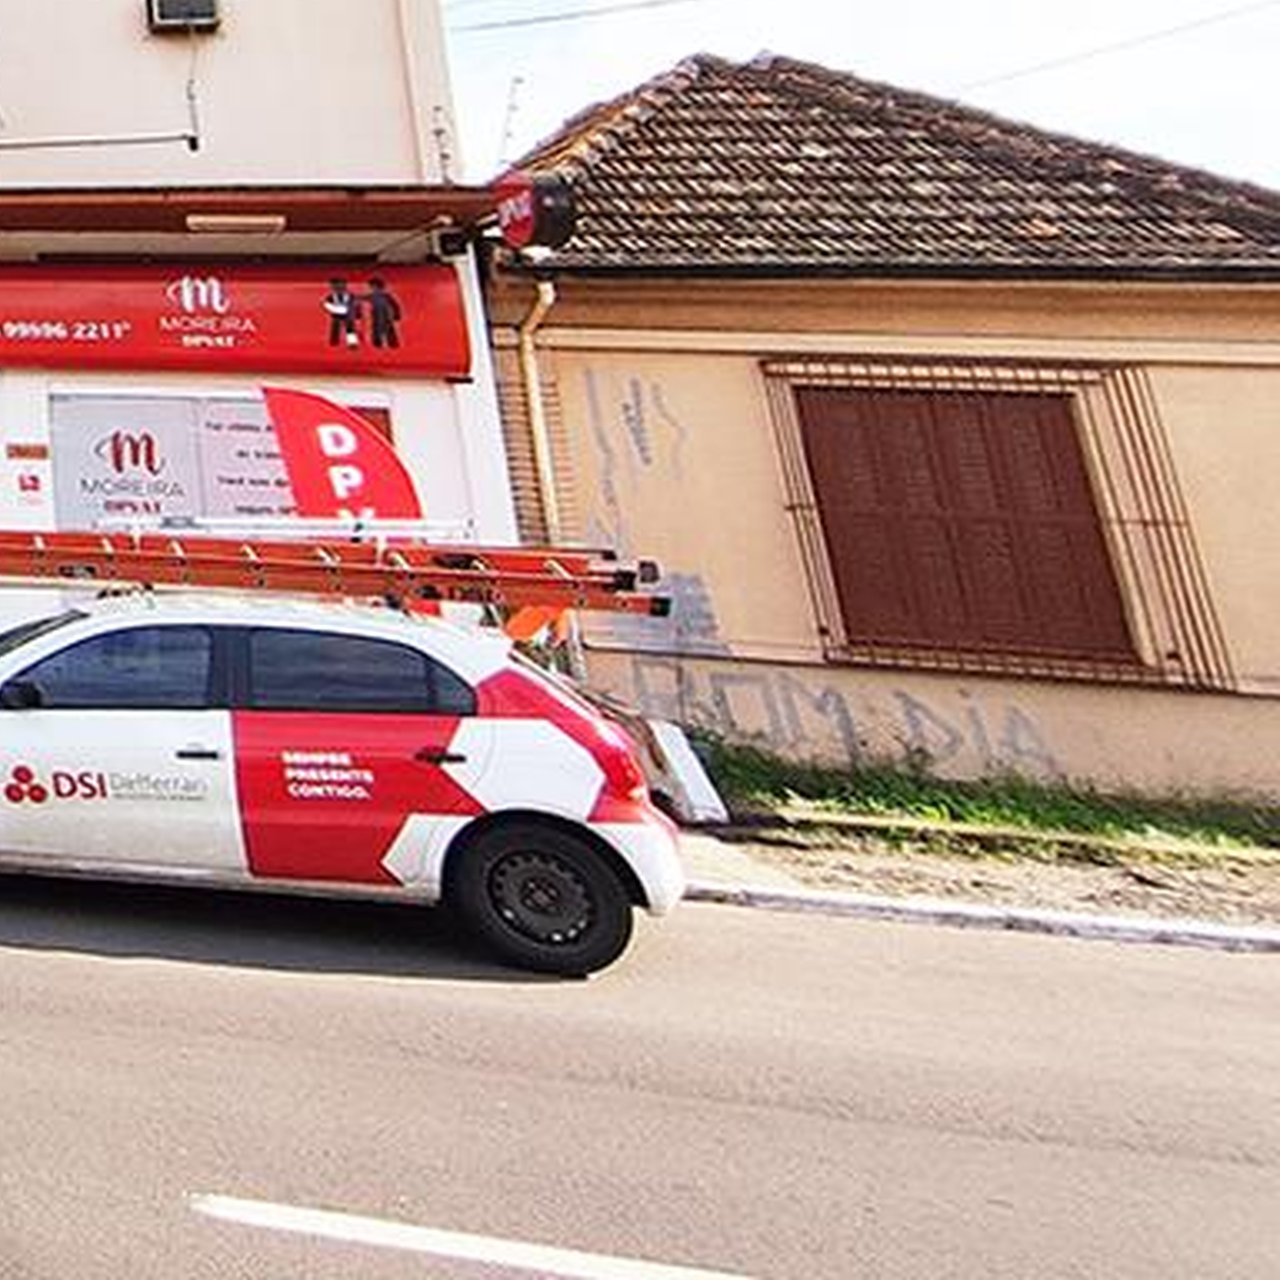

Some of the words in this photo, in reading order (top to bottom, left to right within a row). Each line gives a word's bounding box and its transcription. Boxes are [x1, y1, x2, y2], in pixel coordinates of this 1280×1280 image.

[158, 316, 256, 332] MOREIRA
[79, 478, 186, 497] MOREIRA
[52, 771, 108, 799] DSI
